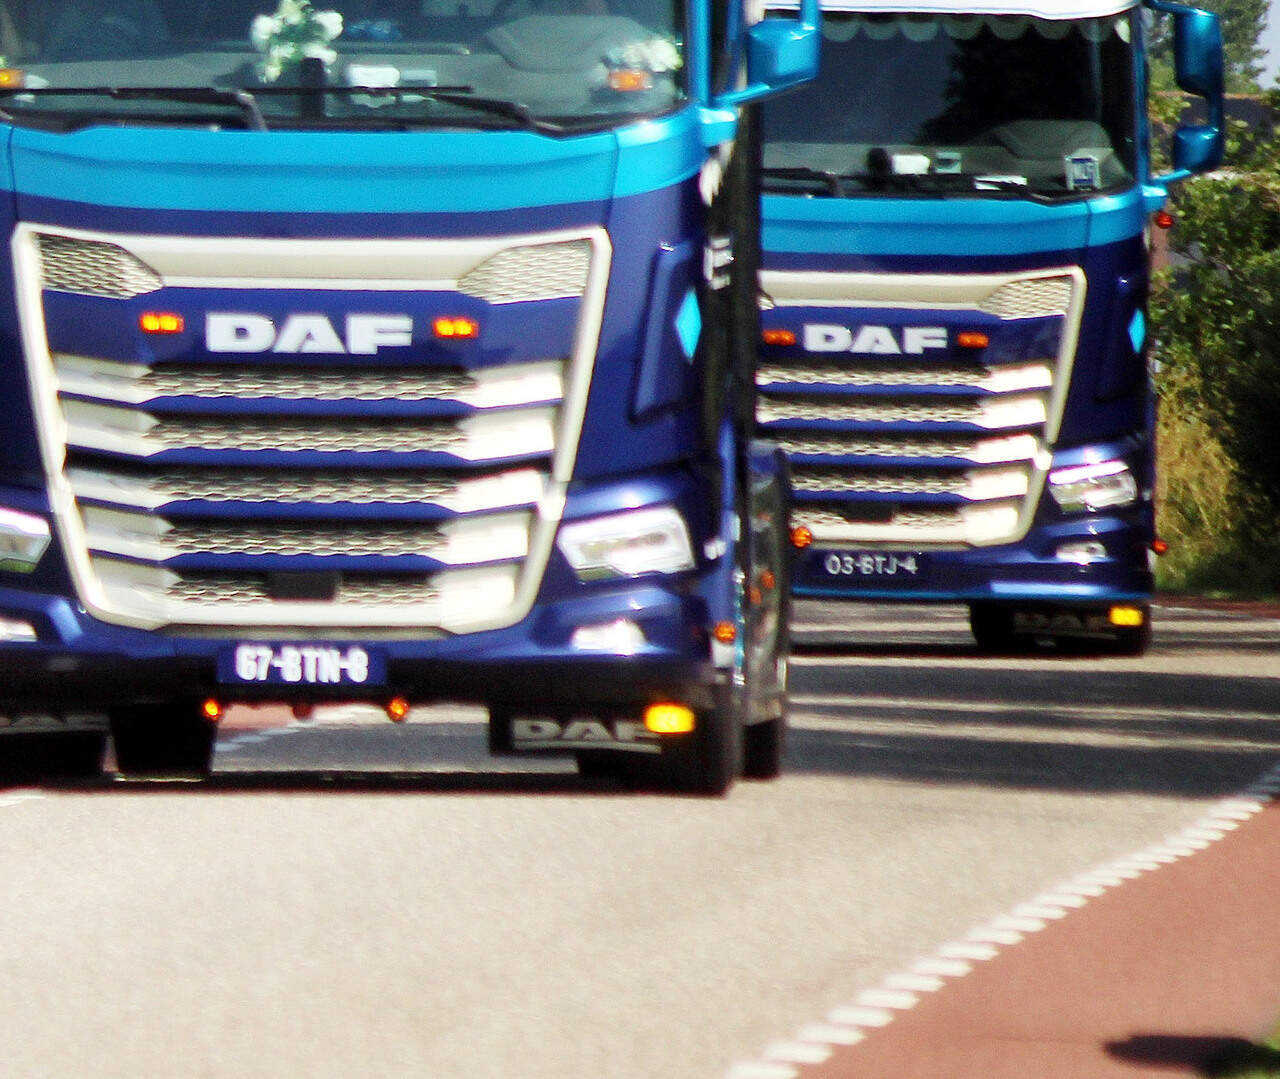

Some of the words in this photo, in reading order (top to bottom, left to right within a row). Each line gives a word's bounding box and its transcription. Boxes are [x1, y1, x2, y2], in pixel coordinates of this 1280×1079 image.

[205, 311, 414, 355] DAF
[803, 323, 948, 355] DAF
[824, 554, 919, 575] 03-BTJ-4
